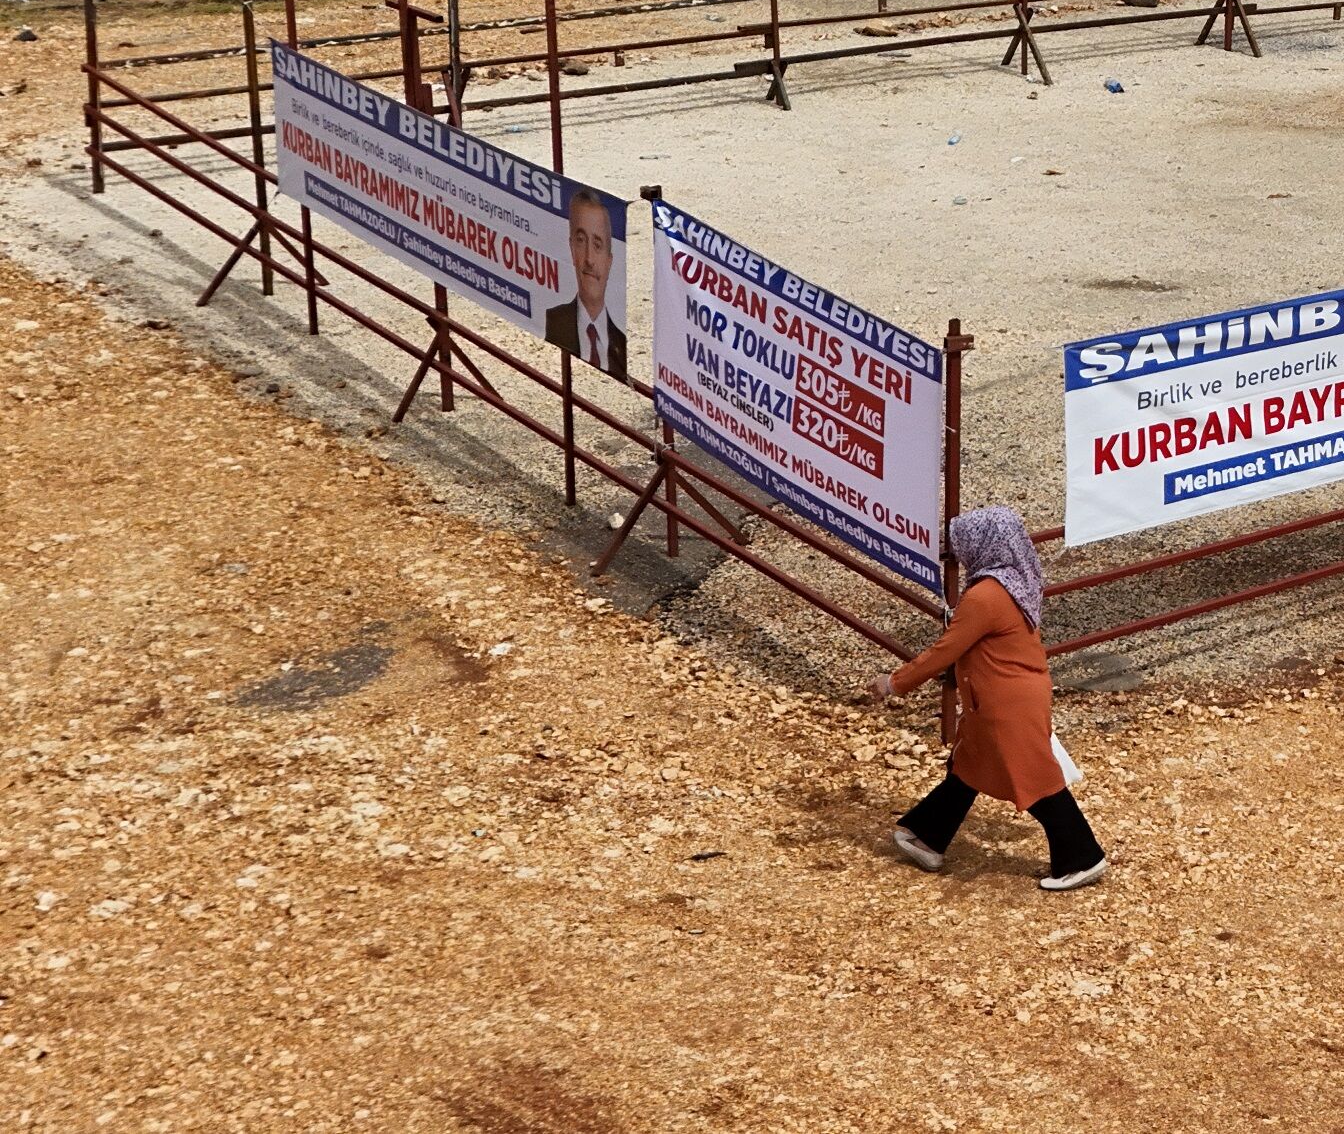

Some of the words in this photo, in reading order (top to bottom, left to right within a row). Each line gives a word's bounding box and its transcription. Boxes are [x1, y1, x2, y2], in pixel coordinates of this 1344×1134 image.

[274, 47, 391, 126] ŞAHİNBEY
[400, 113, 562, 210] BELEDİYESİ
[282, 119, 332, 174] KURBAN
[334, 148, 420, 222] BAYRAMIMIZ
[423, 195, 498, 264] MÜBAREK
[502, 236, 560, 293] OLSUN
[388, 152, 412, 174] sağlık
[413, 165, 423, 178] ve
[425, 166, 456, 196] huzurla
[458, 186, 476, 207] nice
[402, 228, 444, 266] Şahinbey
[446, 255, 488, 288] Belediye
[488, 278, 528, 310] Başkanı
[654, 205, 783, 290] ŞAHİNBEY
[783, 276, 936, 374] BELEDİYESİ
[670, 248, 768, 325] KURBAN
[772, 305, 844, 370] SATIŞ
[851, 345, 912, 404] YERİ
[686, 294, 728, 342] MOR
[732, 320, 796, 380] TOKLU
[686, 334, 720, 380] VAN
[724, 360, 793, 424] BEYAZI
[697, 372, 729, 402] (BEYAZ
[730, 393, 774, 432] CİNSLER)
[1138, 383, 1194, 411] Birlik
[1200, 380, 1222, 397] ve
[1236, 350, 1338, 390] bereberlik
[658, 362, 704, 412] KURBAN
[706, 399, 788, 468] BAYRAMIMIZ
[792, 454, 868, 516] MÜBAREK
[872, 502, 930, 548] OLSUN
[1094, 403, 1253, 476] KURBAN
[1174, 458, 1268, 496] Mehmet
[657, 394, 694, 432] Mehmet
[694, 420, 763, 480] TAHMAZOĞLU
[772, 476, 826, 520] Şahinbey
[827, 500, 882, 552] Belediye
[882, 534, 936, 583] Başkanı
